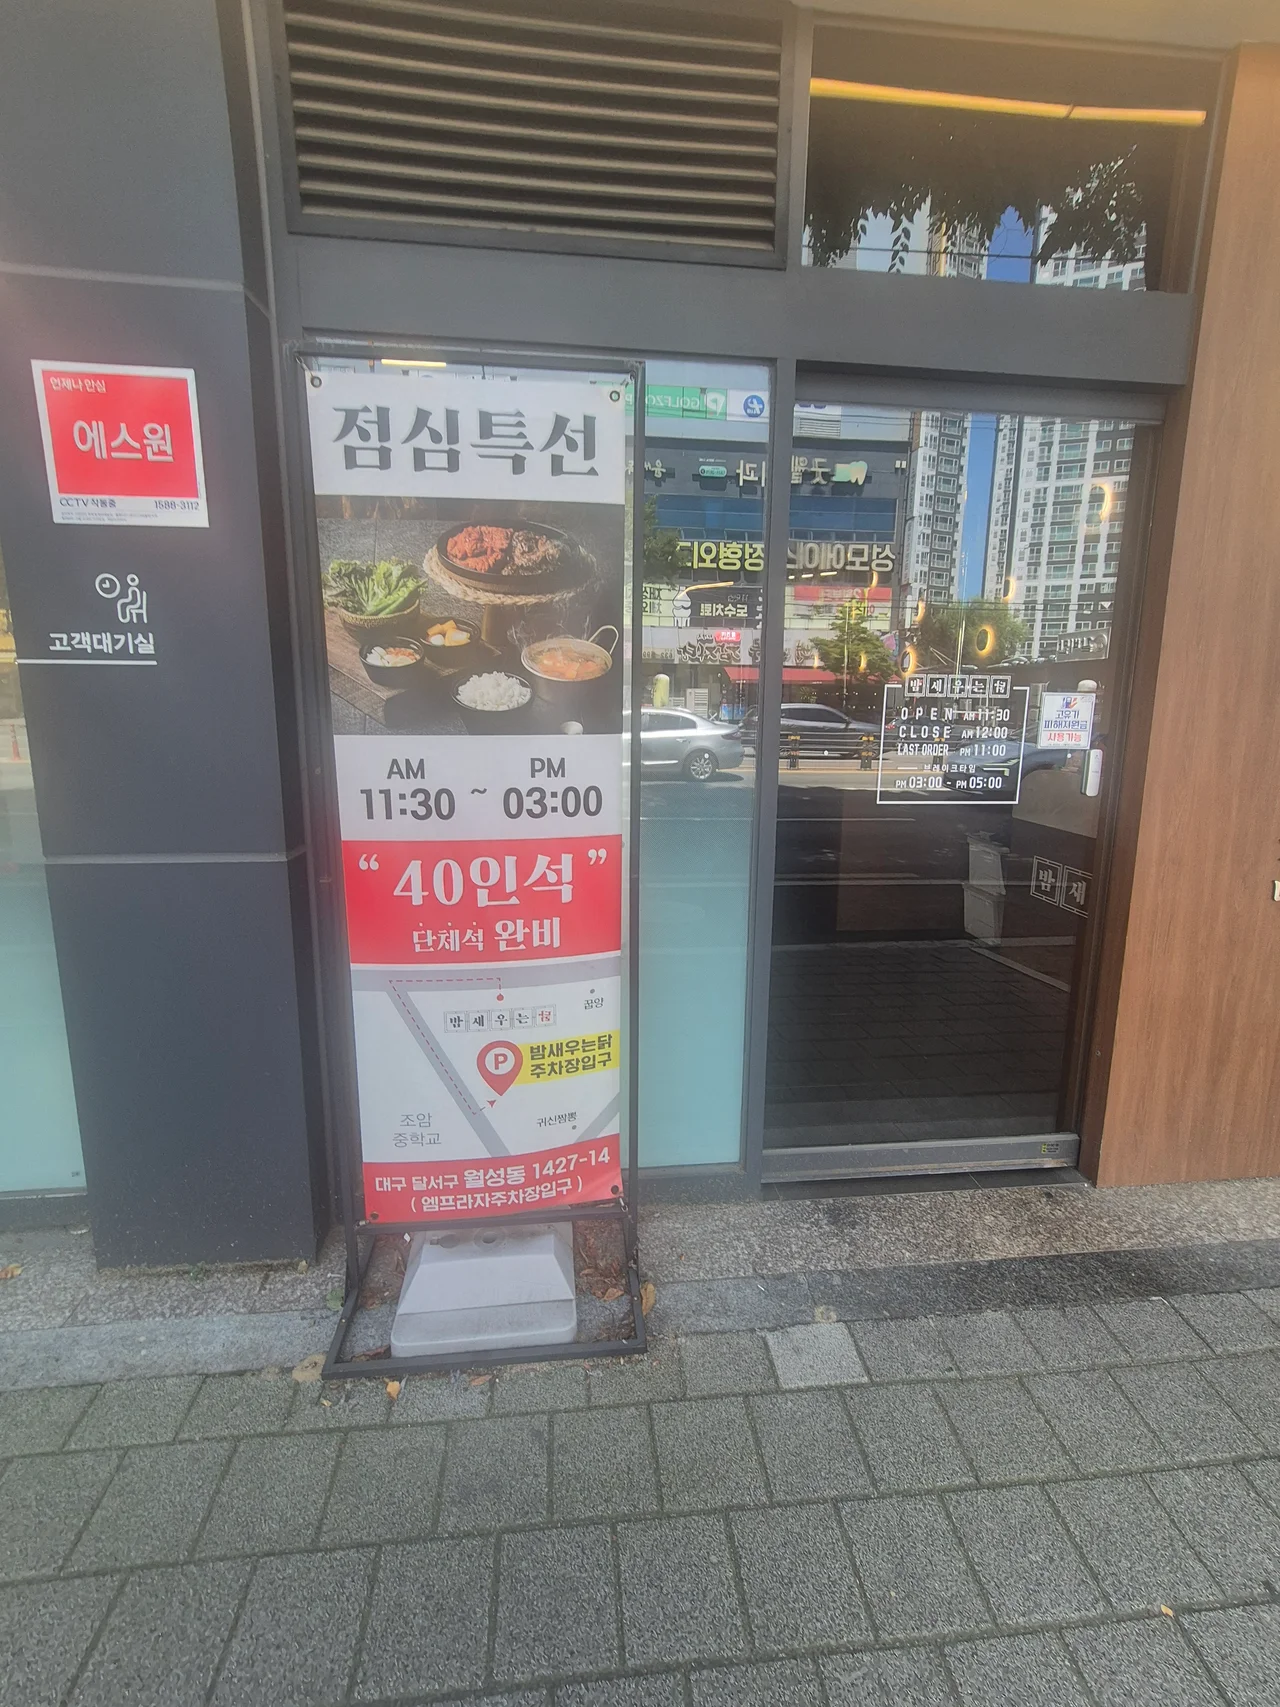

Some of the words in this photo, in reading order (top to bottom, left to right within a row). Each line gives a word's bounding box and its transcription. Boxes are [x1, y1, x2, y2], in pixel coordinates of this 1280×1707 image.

[50, 377, 82, 392] 언제나
[84, 378, 107, 393] 안심
[73, 419, 174, 463] 에스원
[332, 405, 599, 477] 점심특선
[60, 497, 88, 508] CCTV
[154, 499, 200, 512] 1588-3112
[49, 632, 155, 654] 고객대기실
[901, 707, 953, 720] OPEN
[899, 725, 951, 738] CLOSE
[897, 744, 920, 756] LAST
[922, 744, 949, 756] ORDER
[387, 758, 425, 779] AM
[530, 757, 566, 778] PM
[924, 764, 976, 773] 브레이크타임
[360, 788, 456, 821] 11:30
[503, 785, 603, 820] 03:00
[412, 925, 484, 952] 단체석
[494, 917, 561, 952] 완비
[529, 1034, 613, 1061] 밤새우는닭
[494, 1053, 508, 1070] P
[529, 1052, 612, 1079] 주차장입구
[399, 1112, 432, 1128] 조암
[536, 1111, 577, 1128] 귀신짬뽕
[392, 1132, 442, 1148] 중학교
[375, 1176, 407, 1192] 대구
[411, 1174, 459, 1191] 달서구
[464, 1165, 526, 1189] 월성동
[532, 1147, 611, 1179] 1427-14
